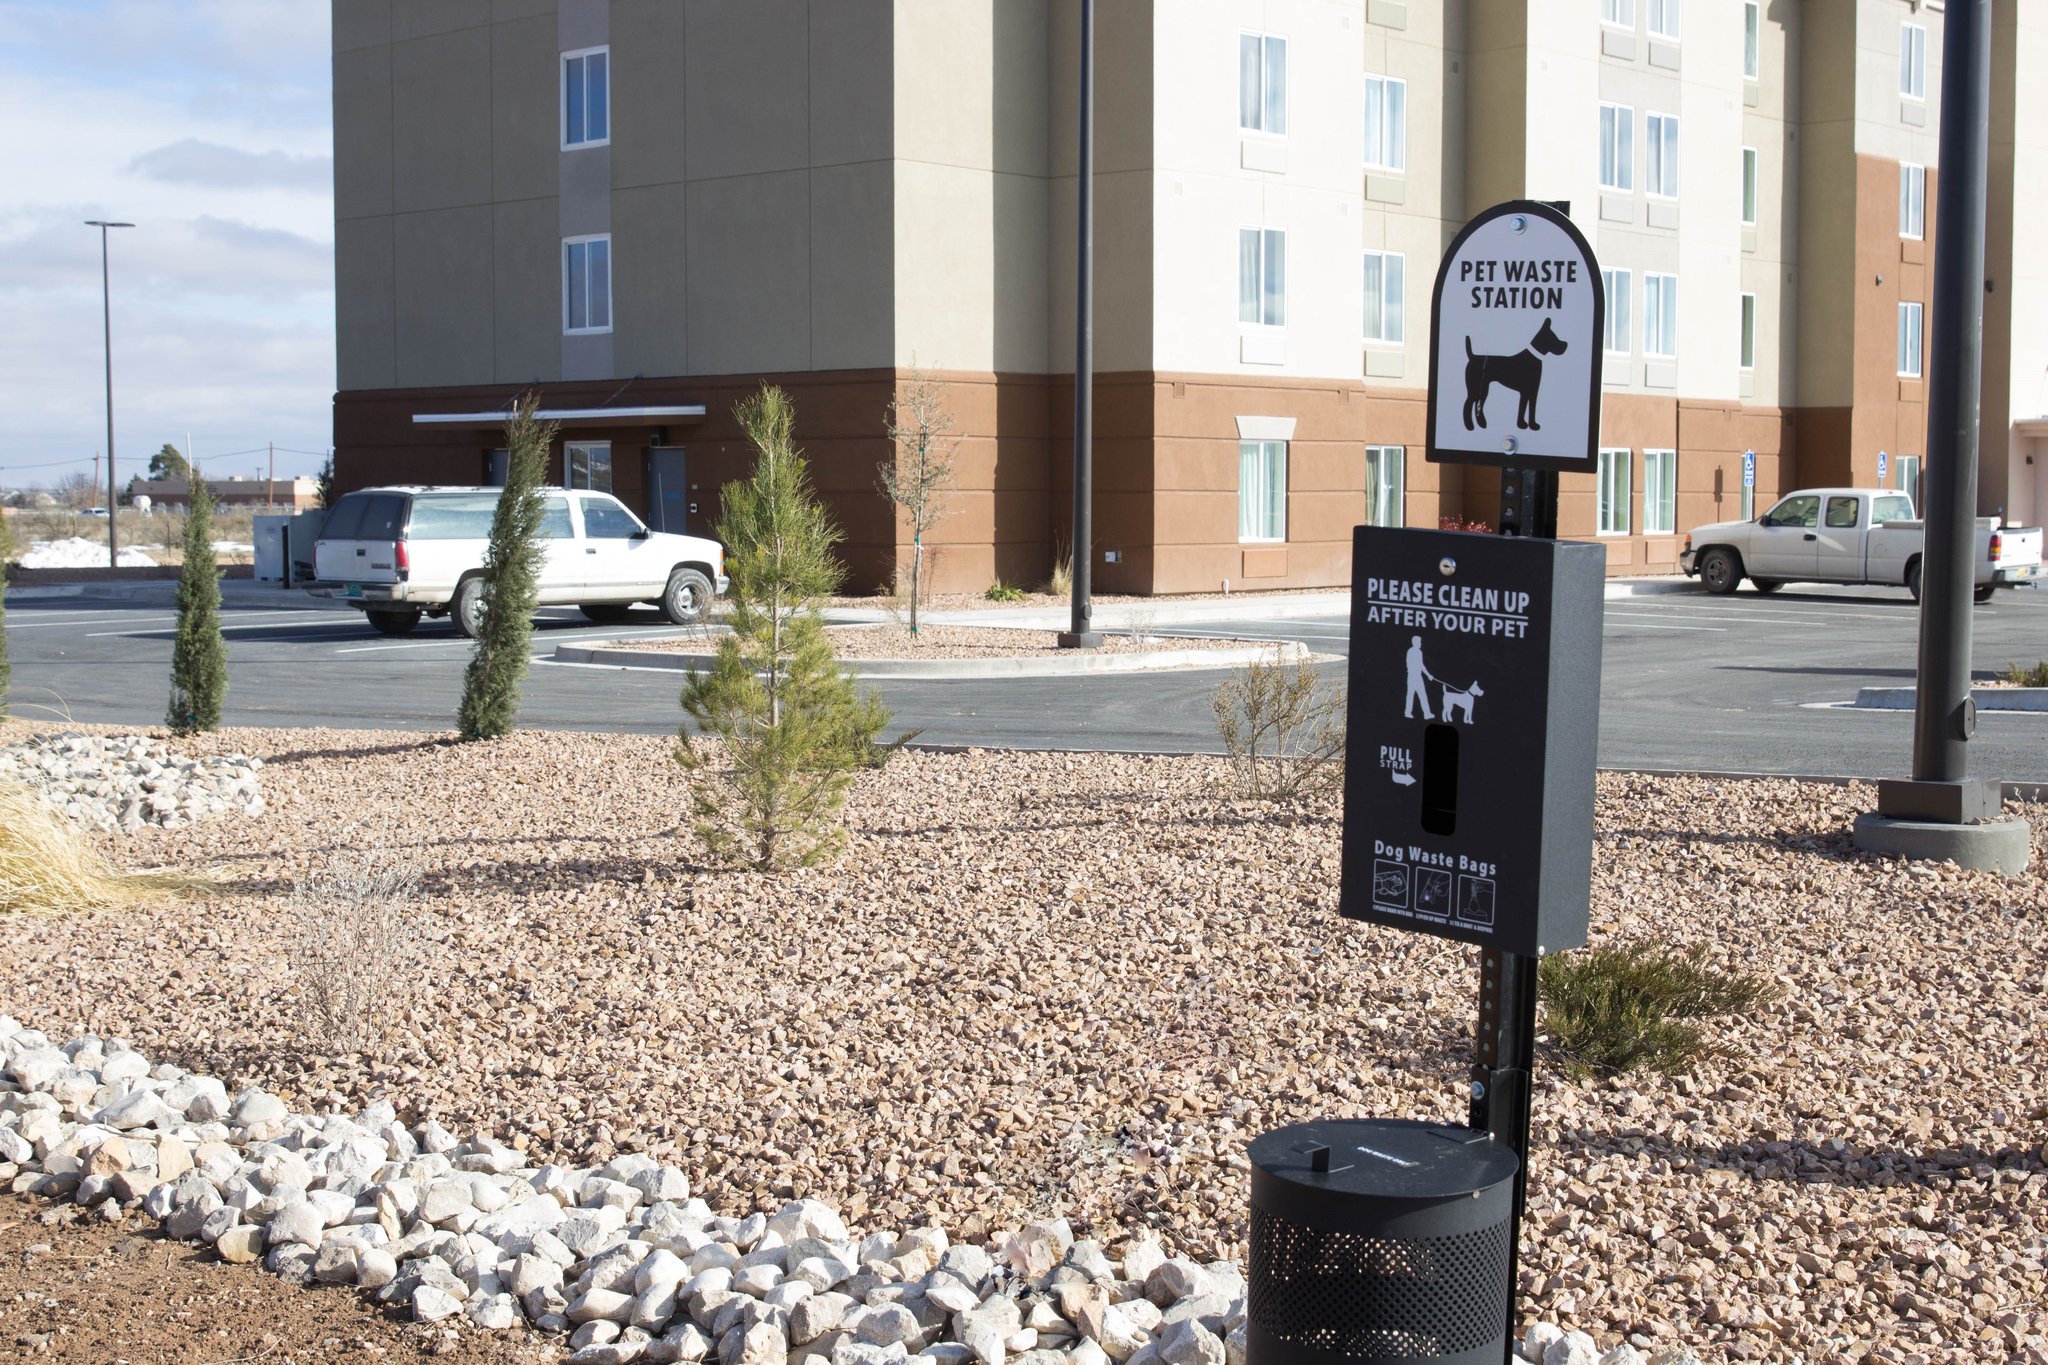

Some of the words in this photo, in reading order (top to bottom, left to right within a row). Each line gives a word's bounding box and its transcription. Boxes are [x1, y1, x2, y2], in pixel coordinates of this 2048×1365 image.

[1460, 260, 1497, 282] PET
[1504, 260, 1577, 283] WASTE
[1471, 286, 1563, 309] STATION
[1367, 577, 1433, 605] PLEASE
[1438, 584, 1498, 611] CLEAN
[1504, 591, 1530, 613] UP
[1367, 605, 1427, 628] AFTER
[1431, 611, 1485, 634] YOUR
[1492, 618, 1529, 638] PET
[1380, 745, 1412, 763] PULL
[1380, 759, 1412, 770] STRAP
[1374, 839, 1403, 863] Dog
[1408, 845, 1454, 868] Waste
[1459, 854, 1497, 878] Bags
